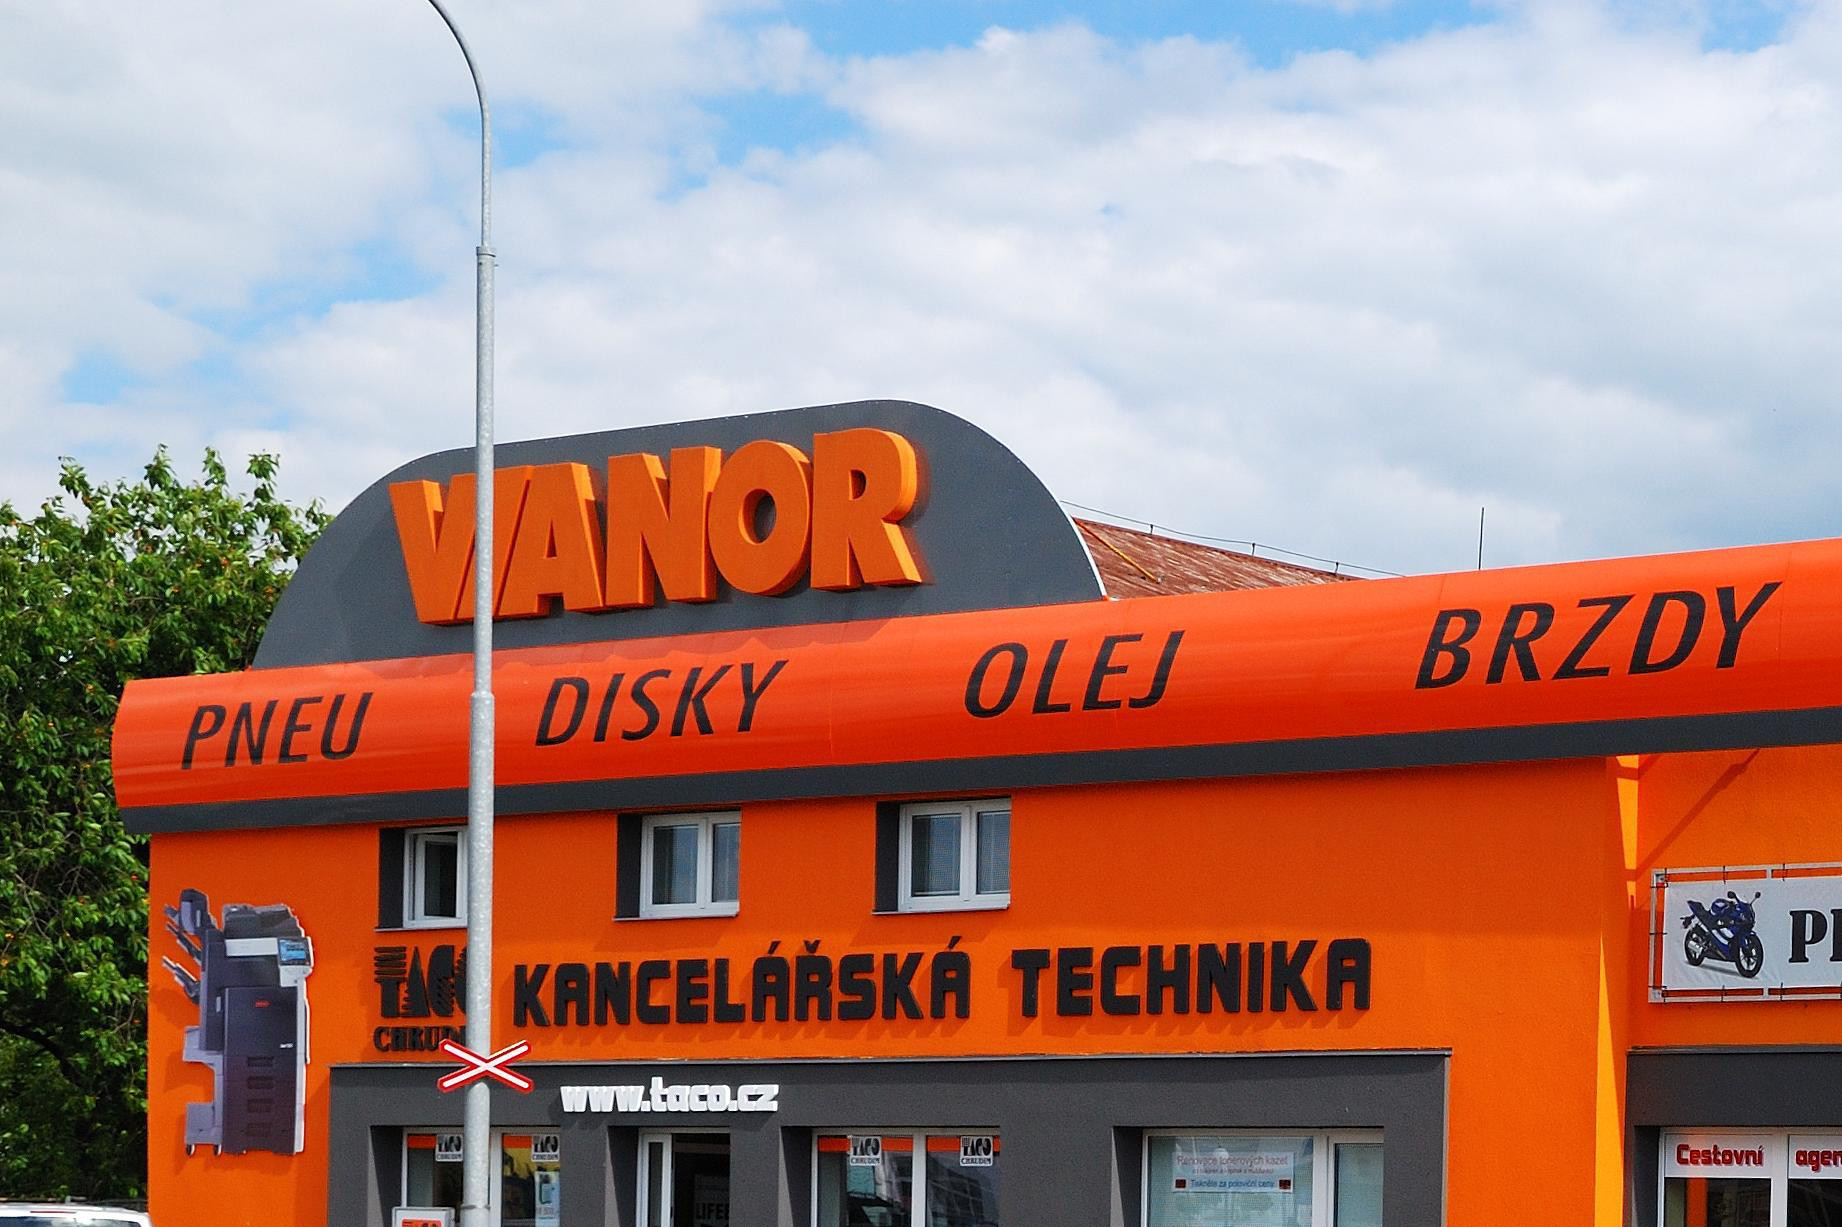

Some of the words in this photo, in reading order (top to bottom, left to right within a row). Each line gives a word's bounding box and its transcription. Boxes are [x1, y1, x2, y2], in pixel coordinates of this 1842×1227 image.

[965, 629, 1185, 718] OLEJ
[1415, 582, 1783, 690] BRZDY
[181, 693, 373, 770] PNEU
[536, 660, 789, 747] DISKY
[513, 936, 971, 1026] KANCELÁŘSKÁ
[1011, 938, 1371, 1017] TECHNIKA
[560, 1077, 778, 1113] www.taco.cz
[1676, 1144, 1764, 1166] Cestovní
